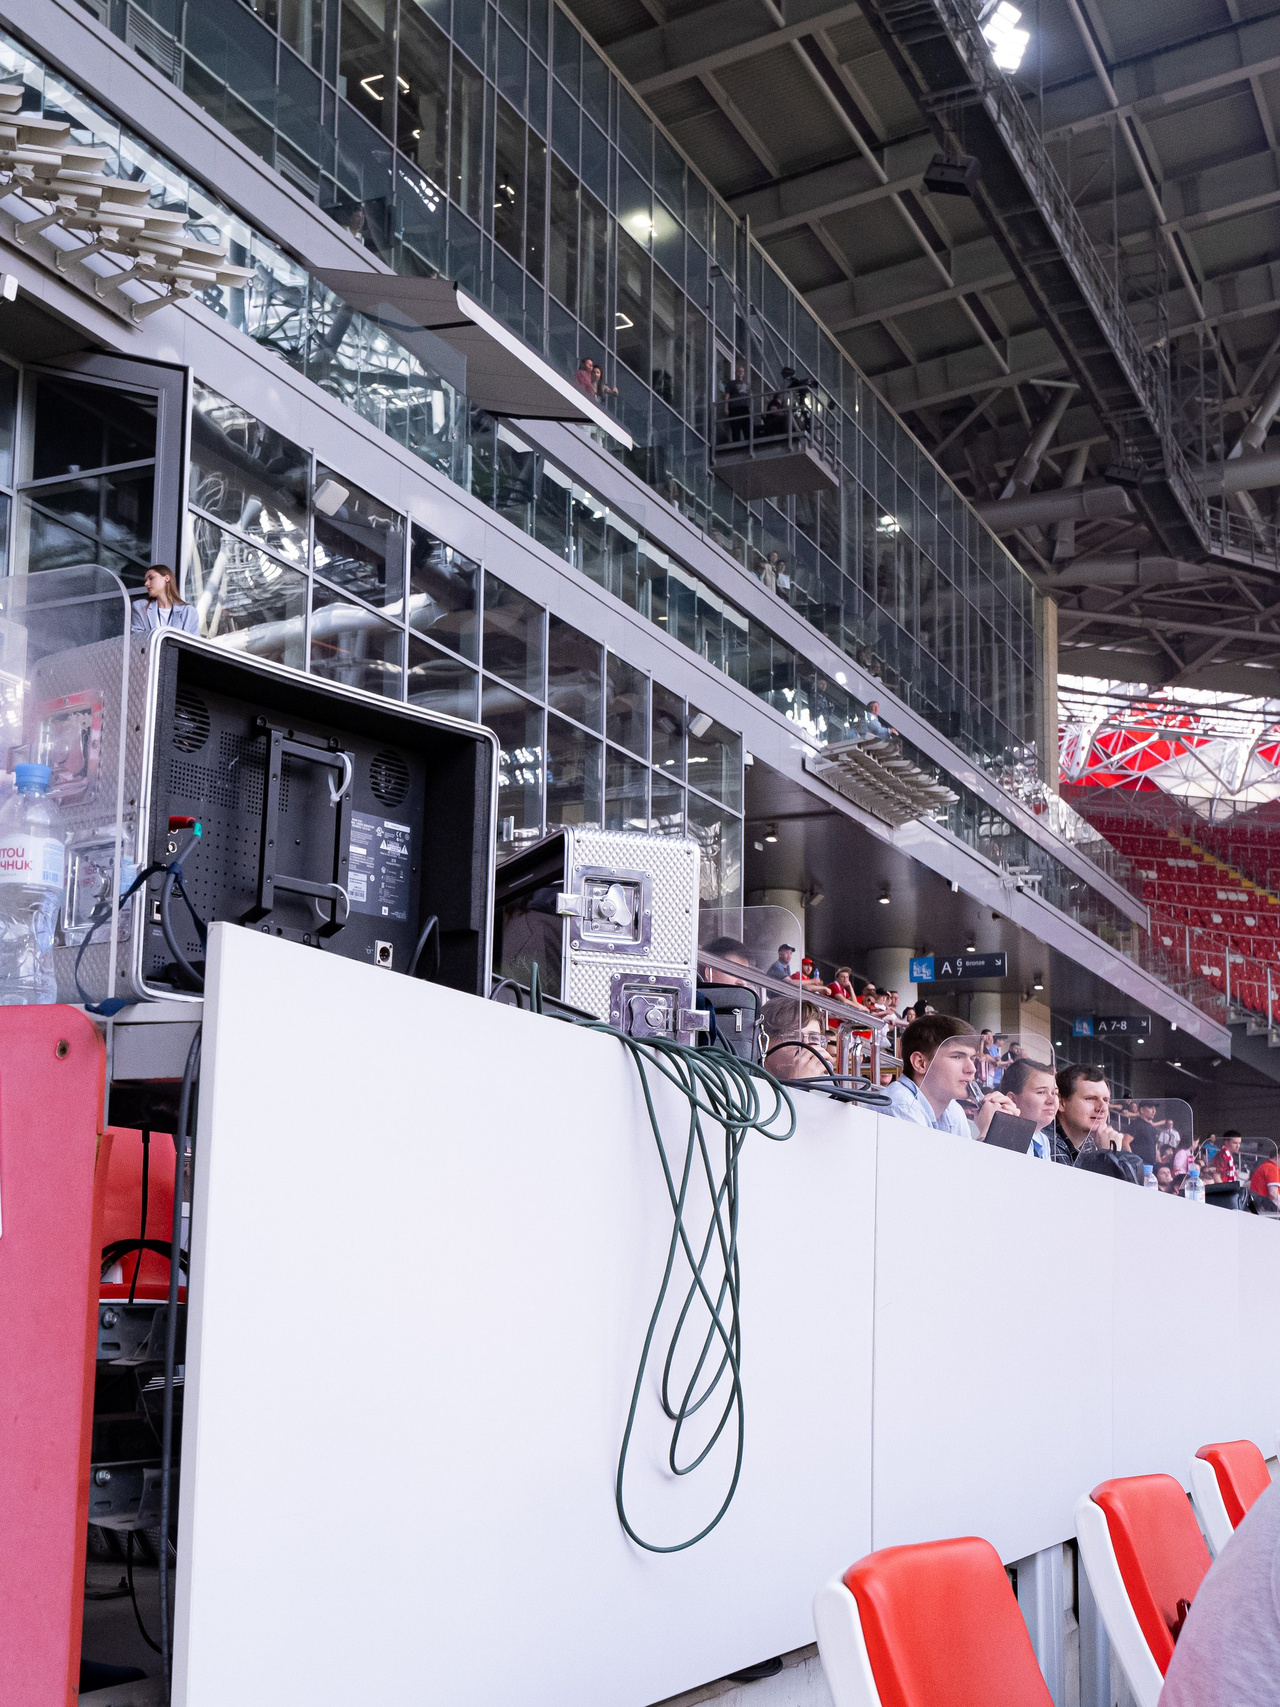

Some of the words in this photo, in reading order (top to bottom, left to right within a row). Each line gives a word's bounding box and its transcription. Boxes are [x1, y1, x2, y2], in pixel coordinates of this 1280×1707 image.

[941, 962, 952, 974] A
[1098, 1021, 1107, 1031] A
[1111, 1021, 1127, 1030] 7-8
